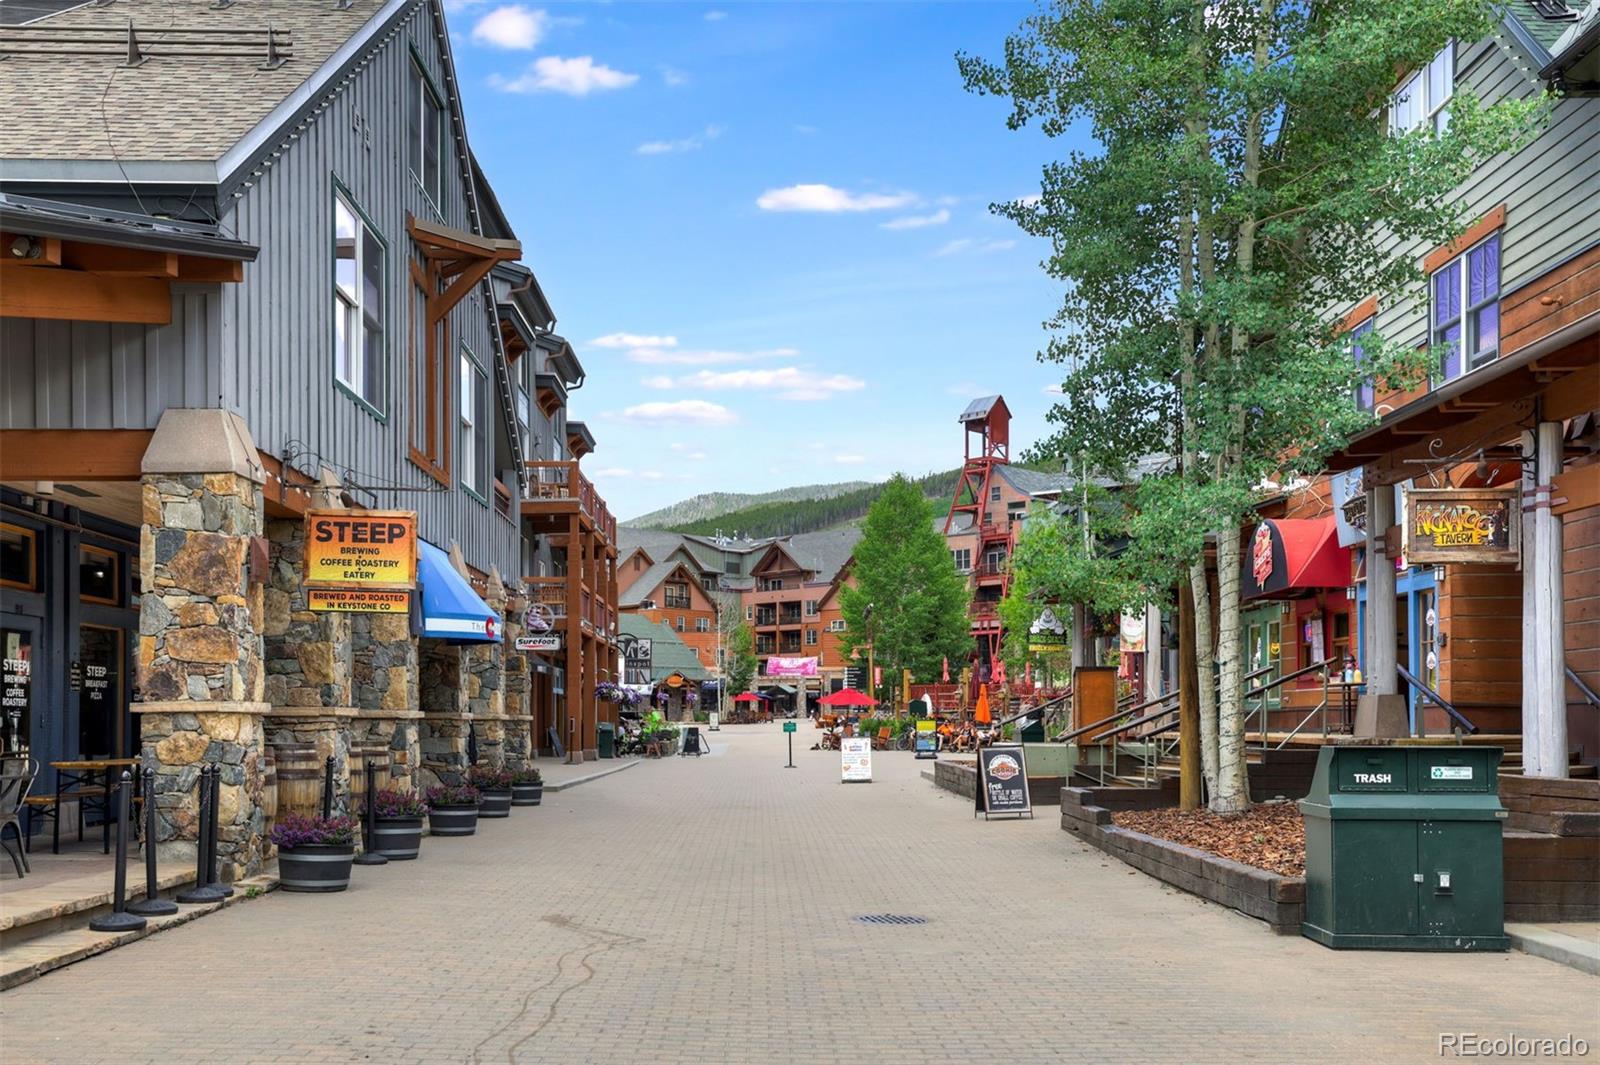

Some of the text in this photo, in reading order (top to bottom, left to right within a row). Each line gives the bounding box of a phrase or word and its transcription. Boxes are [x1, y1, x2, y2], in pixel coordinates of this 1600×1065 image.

[1416, 504, 1494, 536] KICKAPOO
[315, 520, 406, 543] STEEP
[1440, 533, 1473, 543] TAVERN
[340, 547, 380, 555] BREWING
[320, 558, 399, 567] COFFEE ROASTERY
[344, 571, 375, 579] EATERY
[313, 592, 346, 600] BREWED
[349, 593, 366, 601] AND
[338, 602, 377, 610] KEYSTONE
[3, 659, 27, 671] STEEP
[86, 665, 107, 677] STEEP
[6, 688, 25, 697] COFFEE
[2, 697, 27, 707] ROASTERY
[1354, 773, 1391, 783] TRASH
